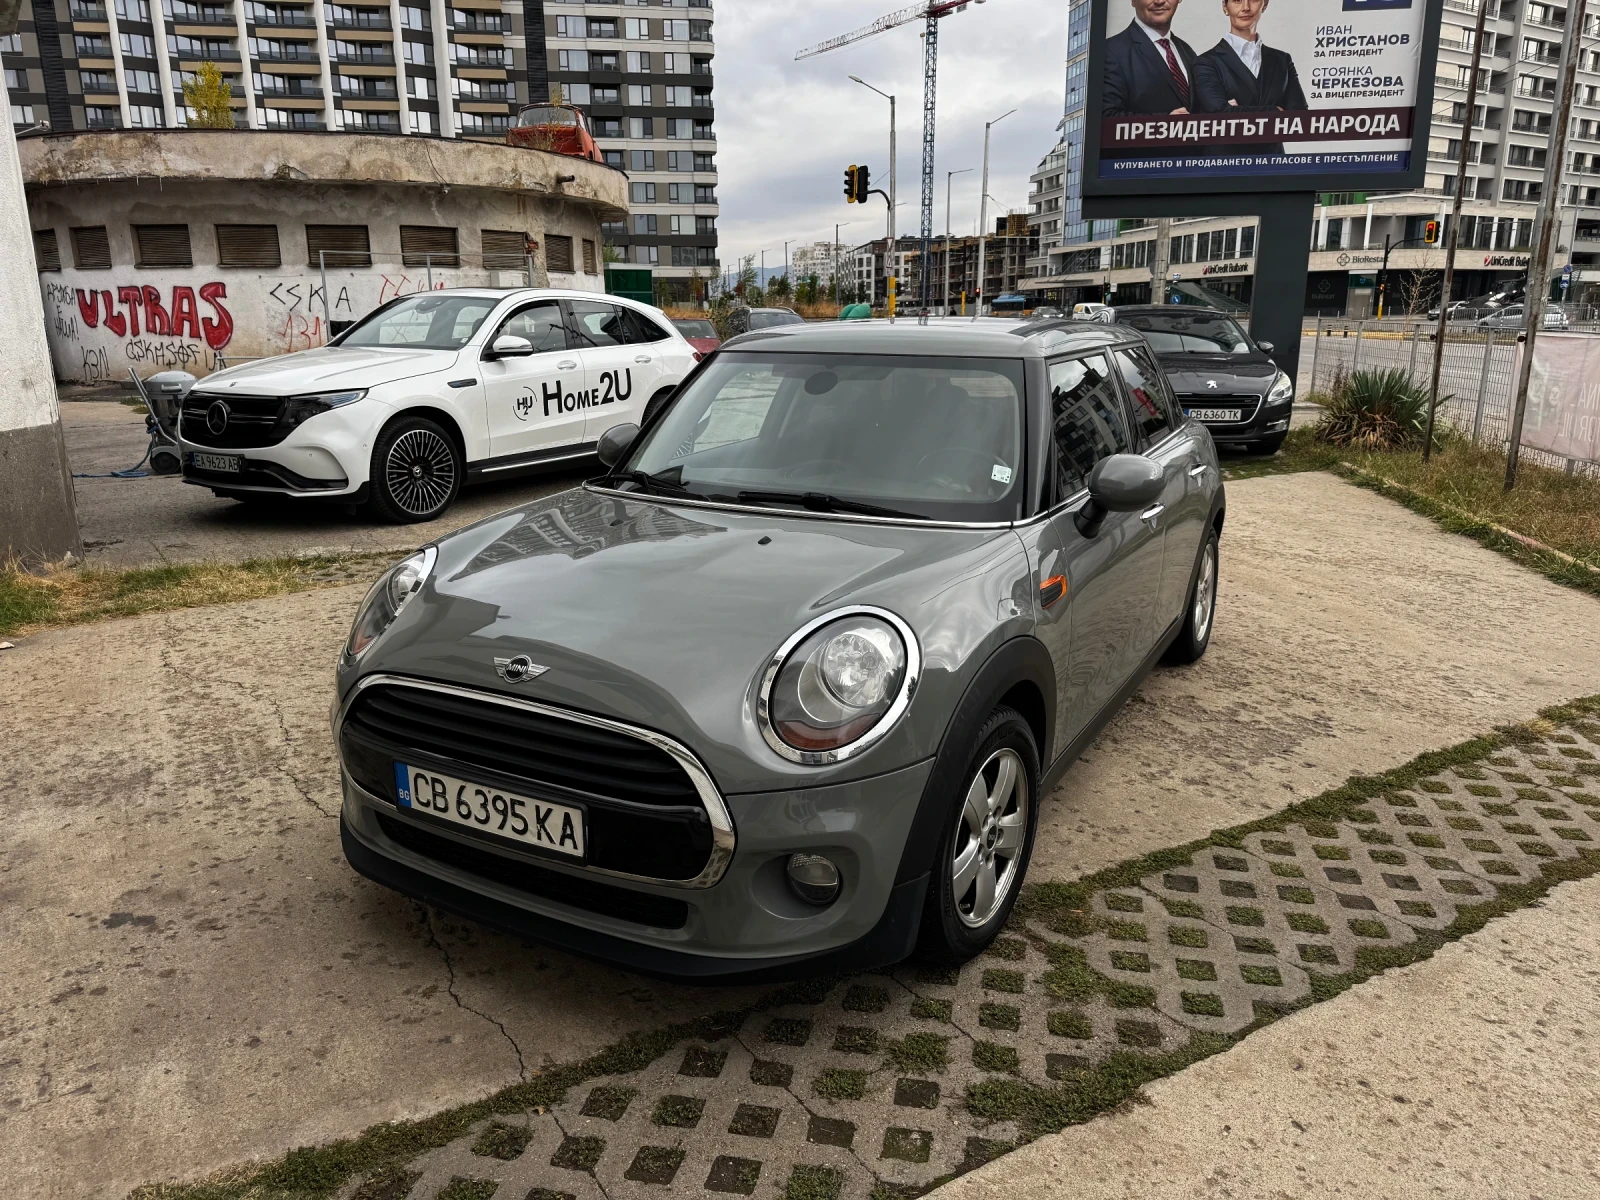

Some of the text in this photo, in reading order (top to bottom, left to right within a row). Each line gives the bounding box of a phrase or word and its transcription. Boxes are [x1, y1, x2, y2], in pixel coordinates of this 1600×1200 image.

[1316, 25, 1352, 36] ИВАН
[1314, 33, 1410, 48] ХРИСТАНОВ
[1313, 48, 1384, 58] ЗА ПРЕЗИДЕНТ
[1312, 65, 1373, 77] СТОЯНКА
[1311, 75, 1404, 89] ЧЕРКЕЗОВА
[1325, 89, 1405, 99] ВИЦЕПРЕЗИДЕНТ
[1115, 114, 1401, 142] ПРЕЗИДЕНТЪТ НА НАРОДА
[1113, 154, 1399, 170] КУПУВАНЕТО И ПРОДАВАНЕТО НА ГЛАСОВЕ Е ПРЕСТЪПЛЕНИЕ
[269, 282, 352, 312] CSKA
[75, 281, 234, 350] ULTRAS
[1190, 410, 1239, 420] CB 6360 TK
[206, 456, 227, 470] 9623
[506, 663, 529, 673] MINI
[399, 788, 410, 801] BG
[413, 772, 579, 851] CB 6395 KA
